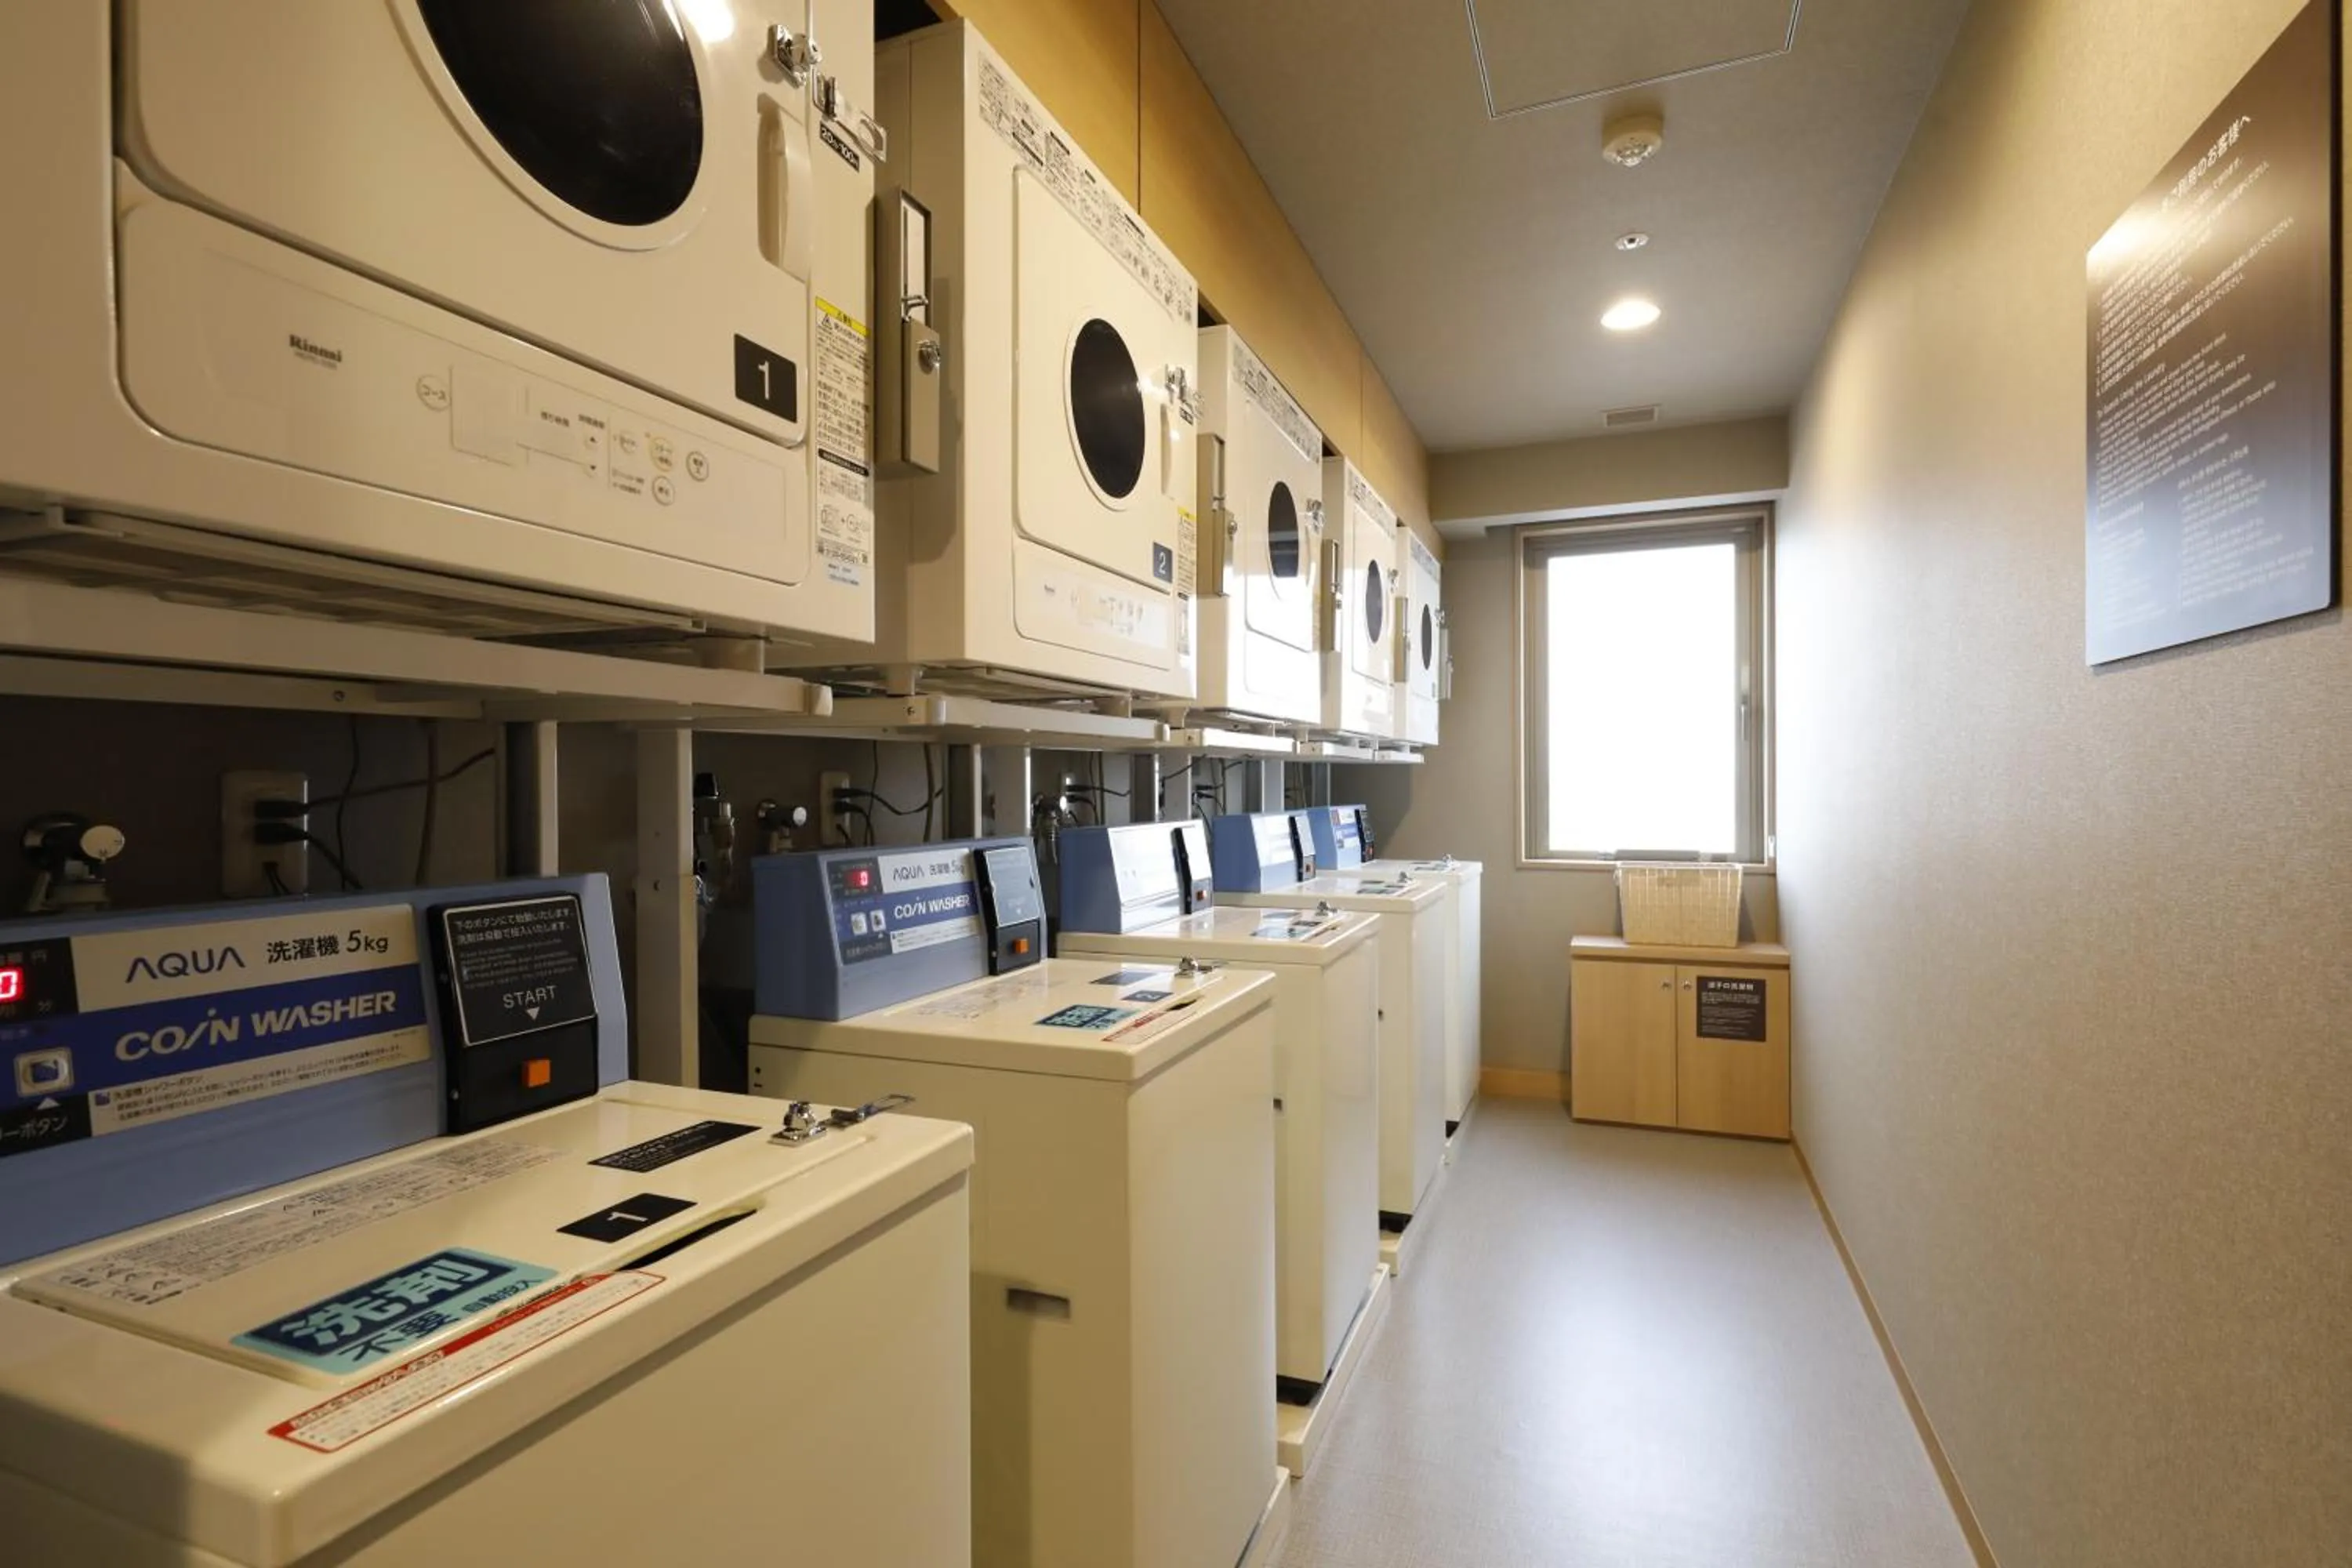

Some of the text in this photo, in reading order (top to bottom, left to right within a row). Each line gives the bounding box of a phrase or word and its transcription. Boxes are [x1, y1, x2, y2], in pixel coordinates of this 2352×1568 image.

[289, 334, 342, 363] Rinnai
[758, 361, 770, 400] 1
[1158, 551, 1167, 575] 2
[893, 864, 925, 880] AQUA
[894, 894, 970, 919] COIN WASHER
[125, 930, 389, 983] AQUA 洗濯機 5kg
[503, 985, 557, 1009] START
[115, 990, 397, 1062] COIN WASHER
[0, 1115, 68, 1142] ーボタン
[607, 1211, 649, 1223] 1
[280, 1258, 489, 1347] 洗剤
[337, 1310, 461, 1363] 不要
